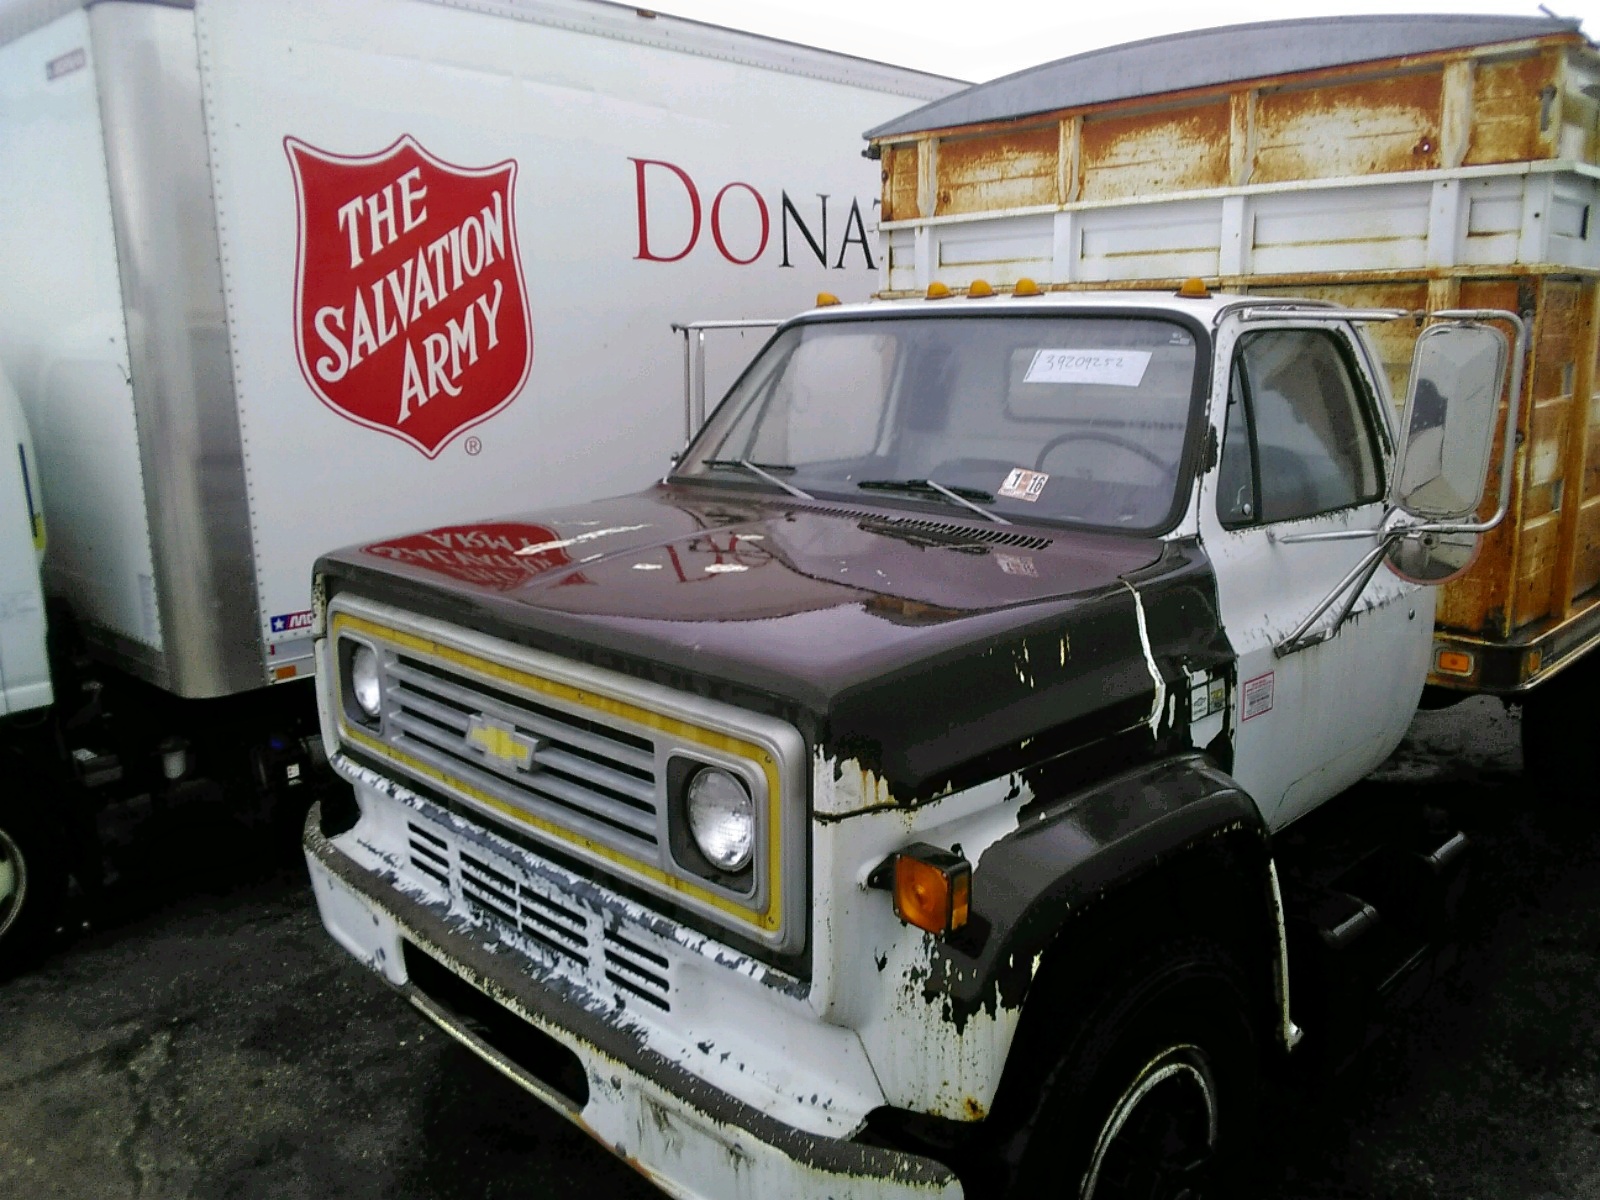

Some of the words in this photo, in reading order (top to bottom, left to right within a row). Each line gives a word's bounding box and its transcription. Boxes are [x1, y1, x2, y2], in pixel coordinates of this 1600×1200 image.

[338, 166, 428, 269] THE
[627, 156, 881, 269] DONA
[314, 190, 505, 382] SALVATION
[397, 278, 503, 424] ARMY
[1029, 475, 1046, 493] 16
